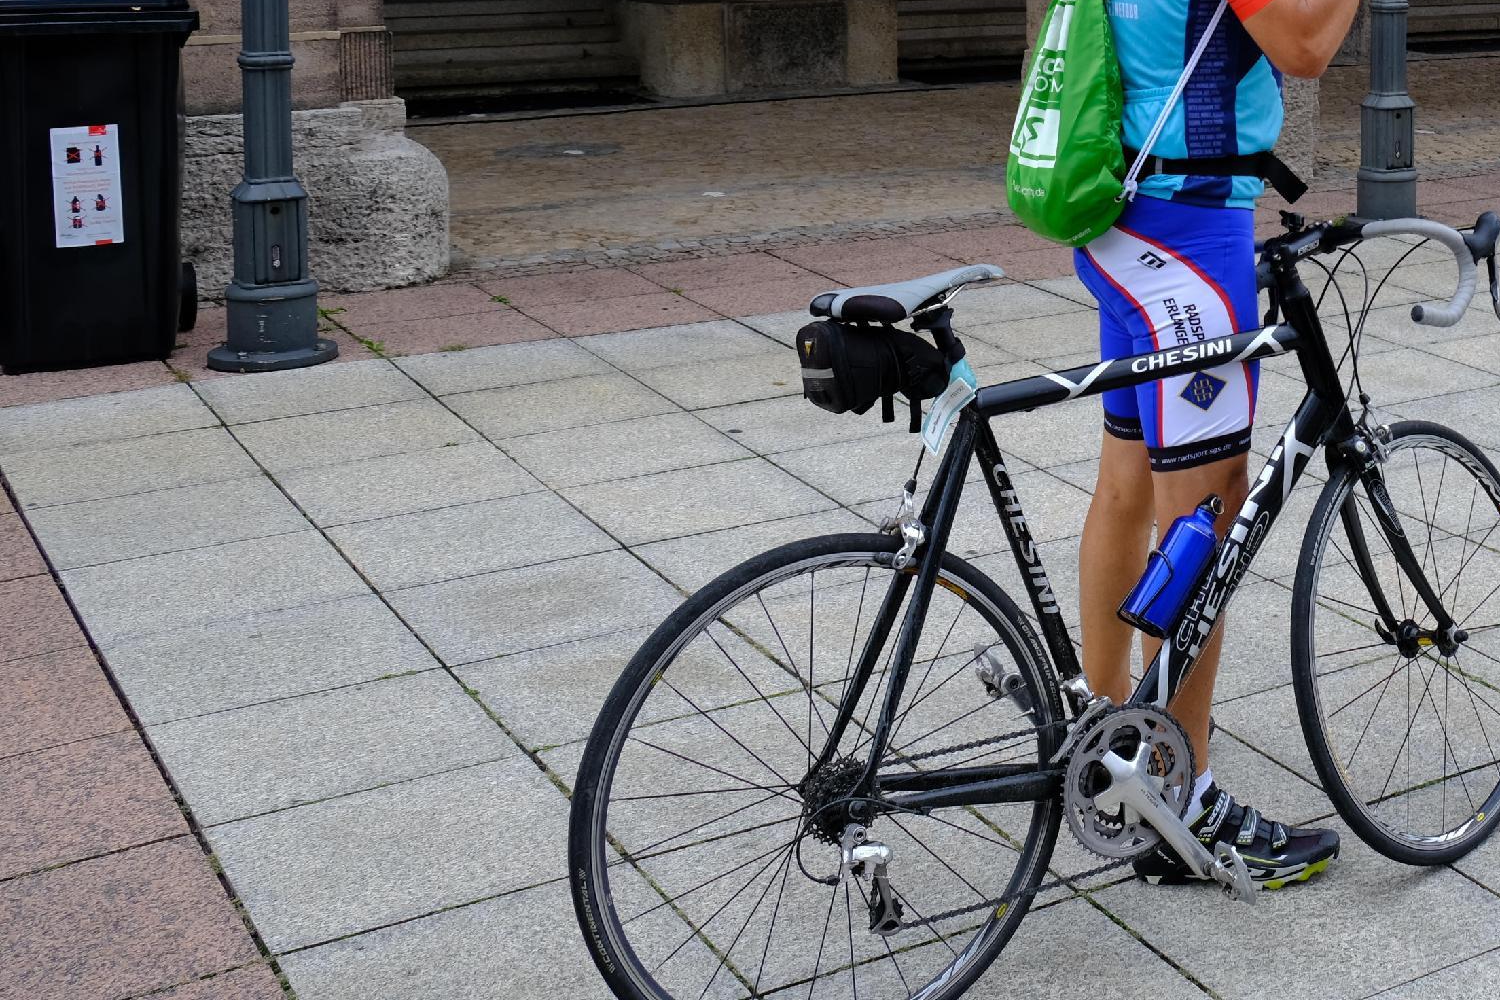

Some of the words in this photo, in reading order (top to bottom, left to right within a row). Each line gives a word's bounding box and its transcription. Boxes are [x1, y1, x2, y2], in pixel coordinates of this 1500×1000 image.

[1163, 297, 1190, 345] ERLANGE
[1183, 303, 1205, 341] RADSP
[1131, 338, 1232, 374] CHESINI
[992, 463, 1060, 614] CHESINI
